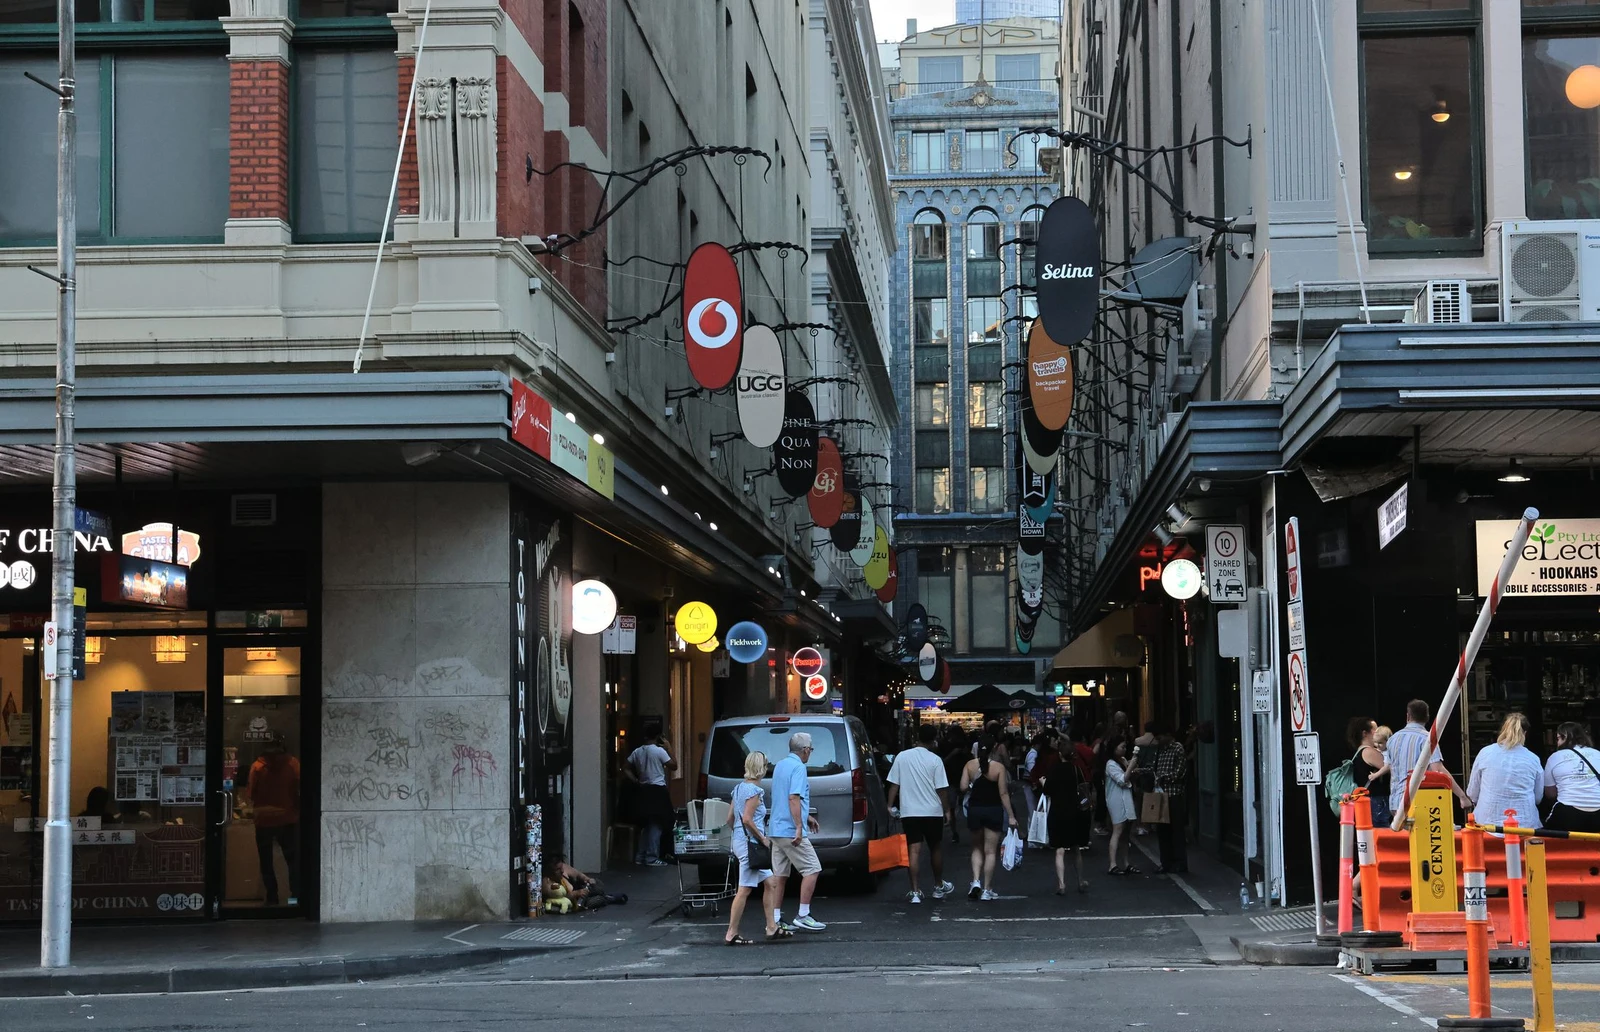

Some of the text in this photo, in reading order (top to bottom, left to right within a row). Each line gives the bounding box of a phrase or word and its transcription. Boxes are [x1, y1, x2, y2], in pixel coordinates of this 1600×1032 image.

[1041, 263, 1094, 280] Selina
[1034, 361, 1058, 371] happy
[1037, 366, 1064, 376] travels
[738, 375, 783, 392] UGG
[1035, 379, 1067, 387] backpacker
[18, 528, 113, 554] CHNA
[140, 536, 167, 546] TASTE
[1220, 538, 1231, 550] 10
[1558, 532, 1578, 545] Pty
[1218, 569, 1237, 577] ZONE
[1540, 566, 1598, 580] HOOKAHS
[1505, 584, 1528, 593] OBILE
[1532, 583, 1587, 593] ACCESSORIES
[517, 539, 527, 666] TOWN
[684, 622, 709, 631] onigiri
[729, 638, 762, 646] Fieldwork
[1256, 700, 1267, 710] ROAD
[517, 681, 526, 799] HALL
[1300, 738, 1308, 749] NO
[1297, 753, 1316, 764] THROUGH
[1300, 768, 1314, 780] ROAD
[1429, 806, 1443, 875] CENTSYS
[91, 896, 149, 909] CHINA
